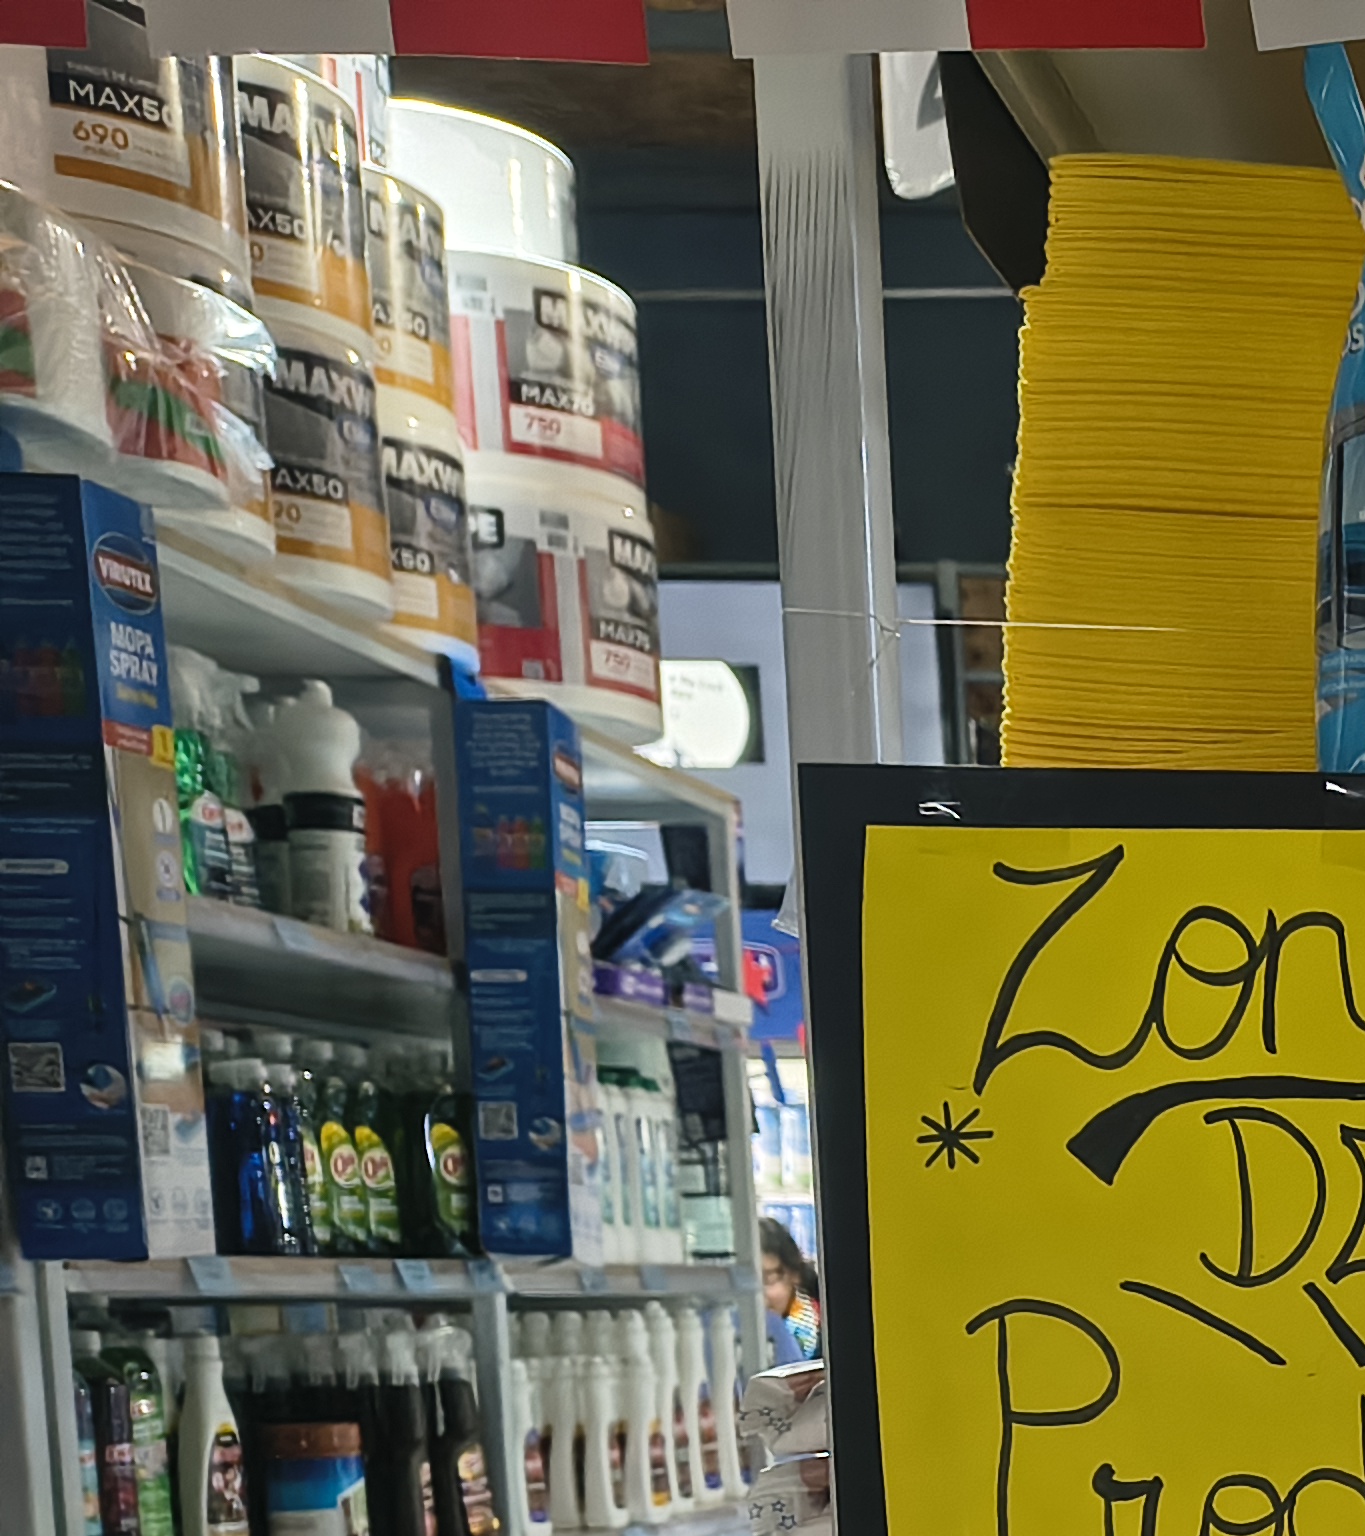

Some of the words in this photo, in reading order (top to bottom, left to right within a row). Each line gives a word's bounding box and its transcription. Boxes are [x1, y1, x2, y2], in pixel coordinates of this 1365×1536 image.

[72, 120, 129, 149] 690
[109, 621, 156, 660] MOPA
[109, 651, 159, 687] SPRAY
